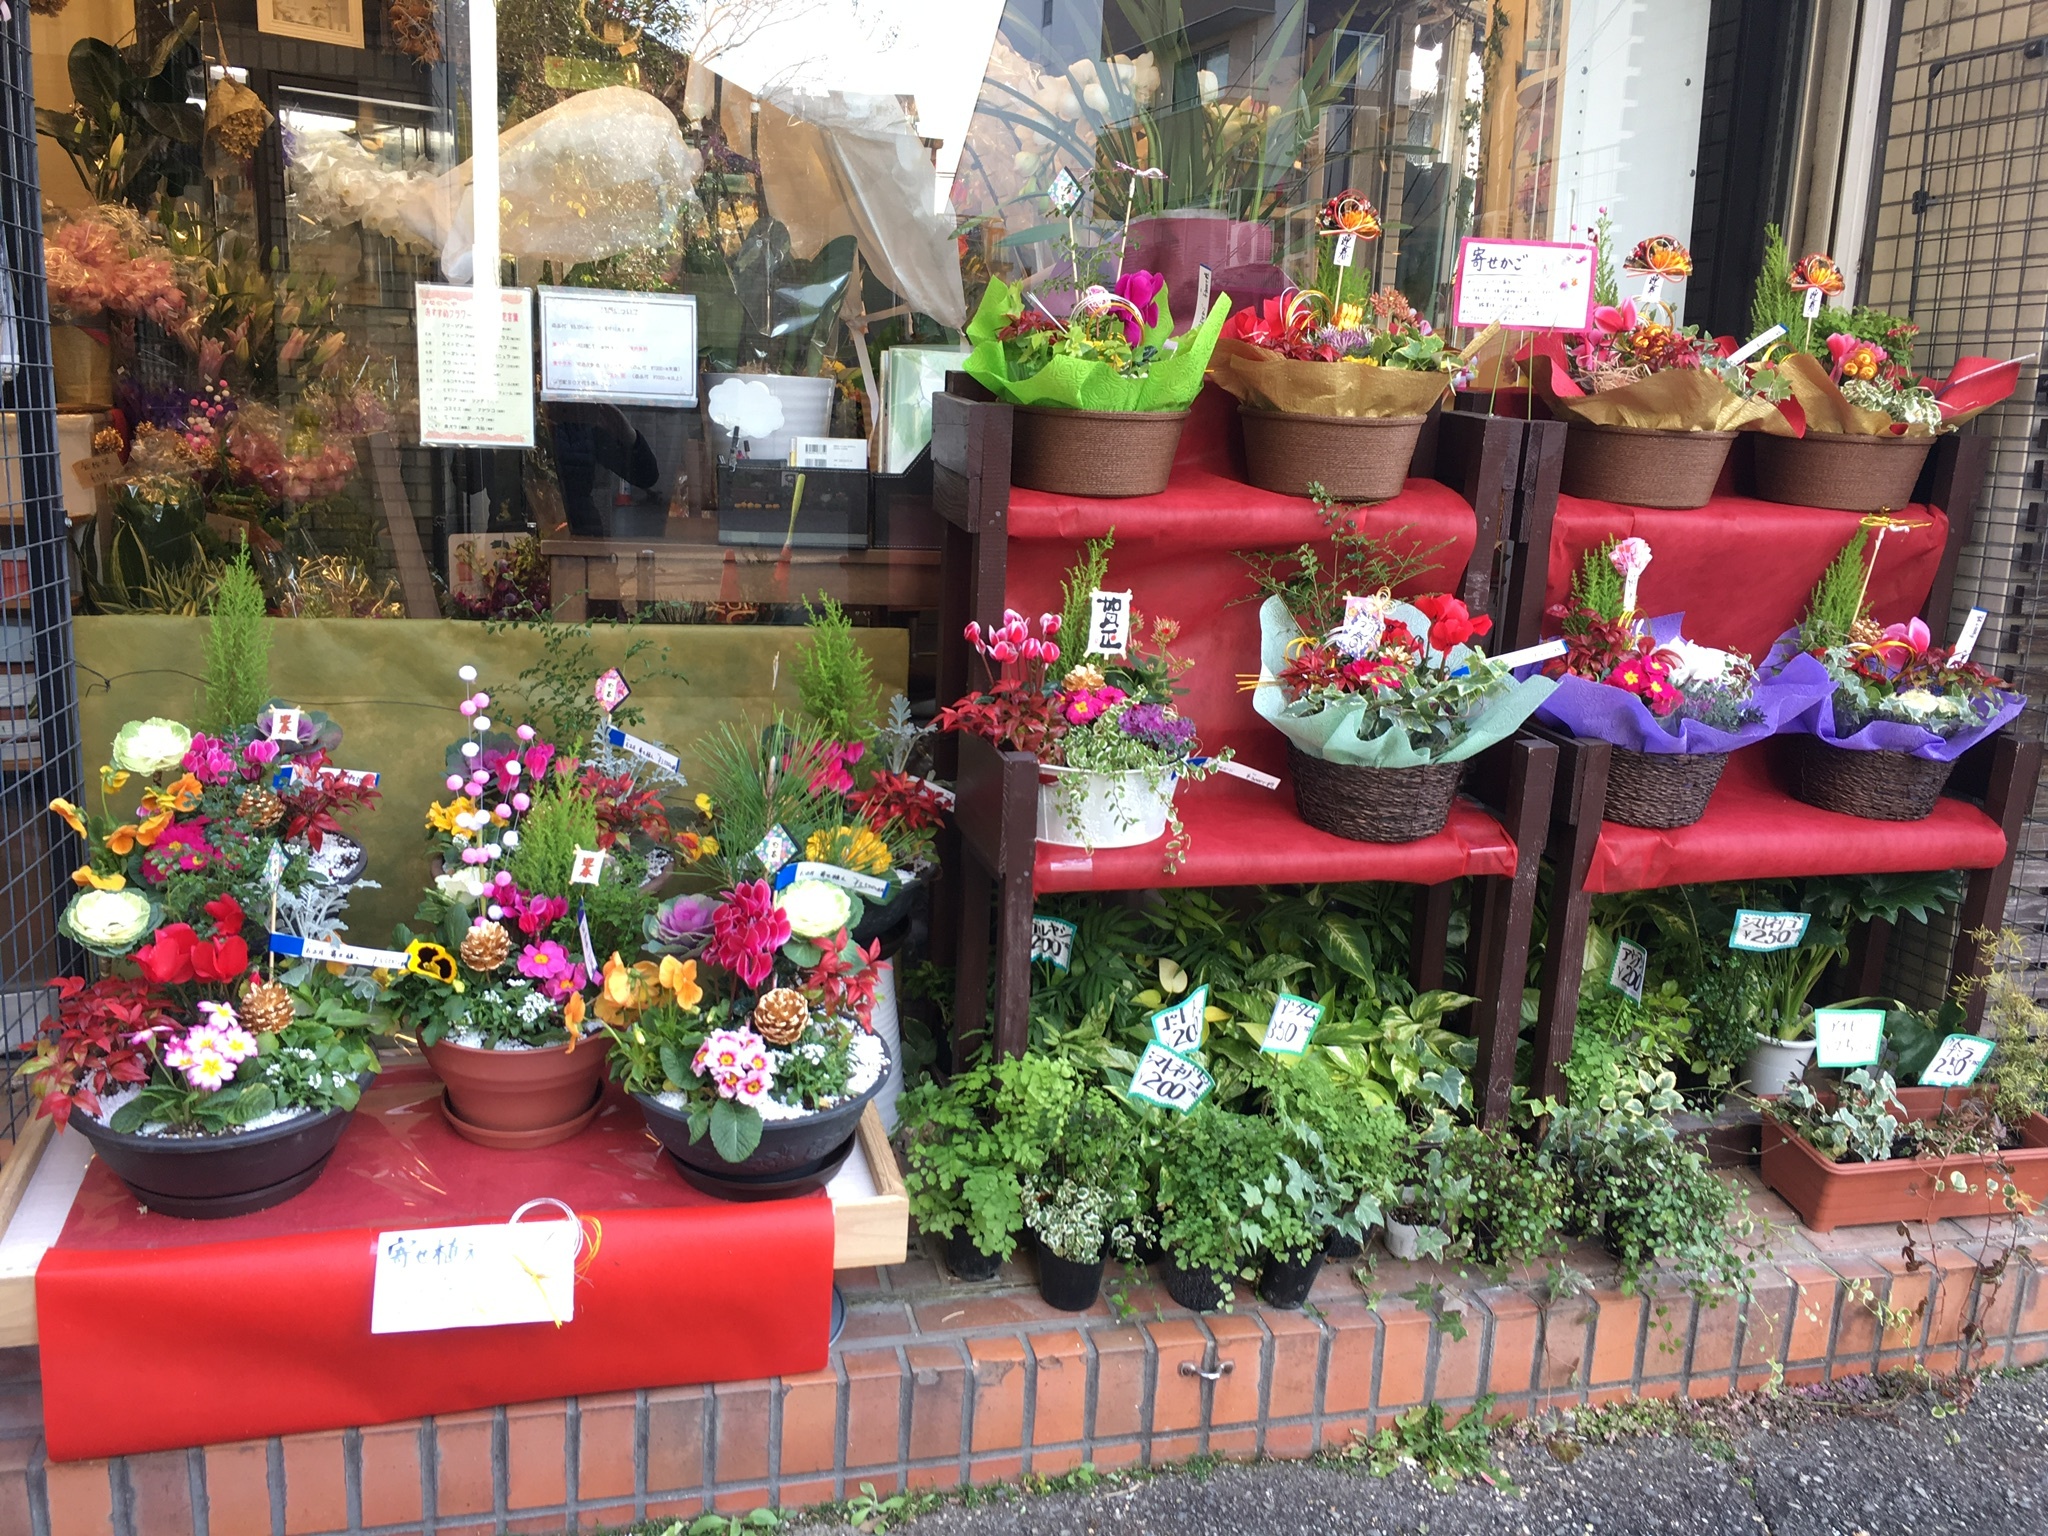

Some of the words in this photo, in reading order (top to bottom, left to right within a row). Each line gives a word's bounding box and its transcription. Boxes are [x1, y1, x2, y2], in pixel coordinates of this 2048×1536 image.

[1339, 233, 1352, 260] 迎春
[1470, 246, 1529, 272] 寄せかご
[1096, 595, 1122, 650] 賀正
[1743, 929, 1792, 944] ¥250
